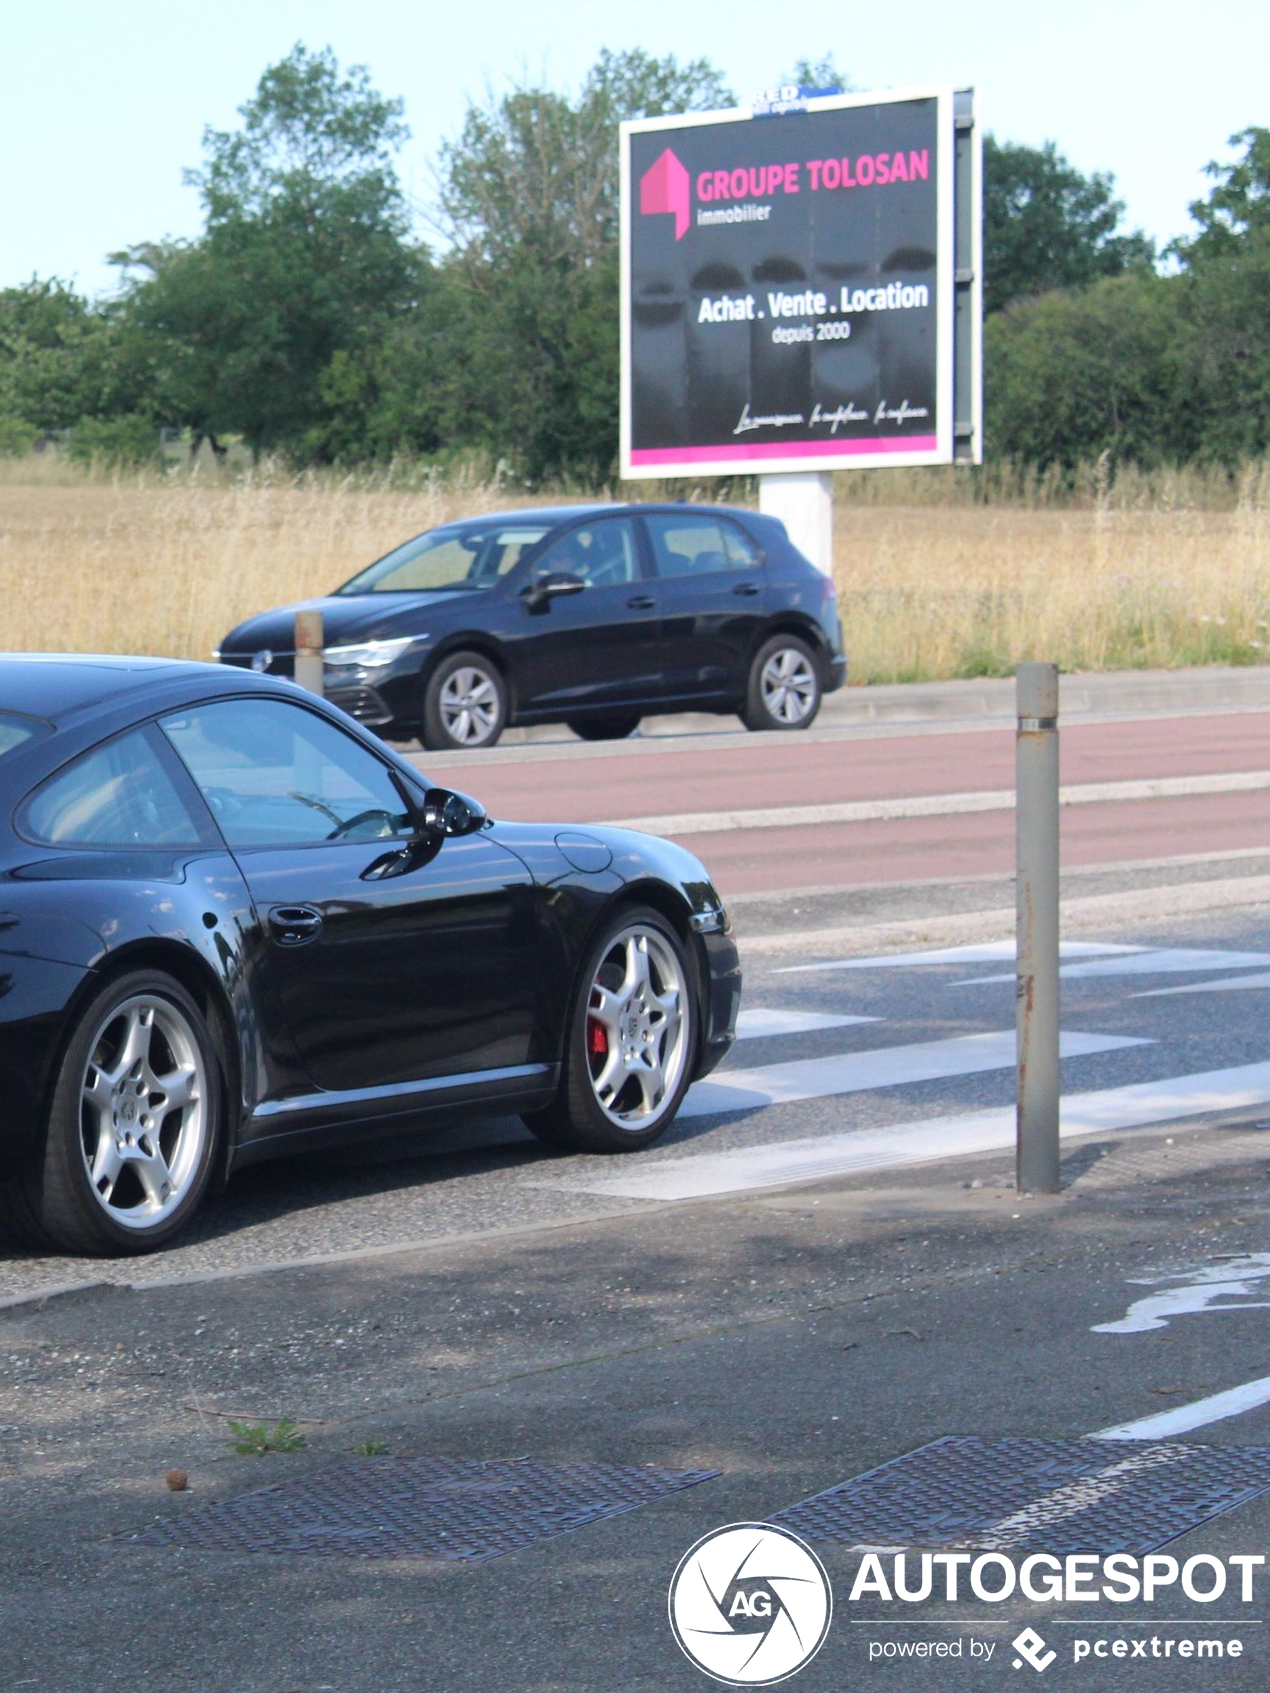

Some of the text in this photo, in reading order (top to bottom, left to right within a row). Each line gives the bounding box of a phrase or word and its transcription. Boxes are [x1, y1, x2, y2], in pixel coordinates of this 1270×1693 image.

[696, 149, 929, 201] GROUPE TOLOSAN
[696, 203, 772, 226] immobilier
[767, 289, 827, 318] Vente
[840, 281, 929, 313] Location
[771, 321, 851, 346] depuis 2000
